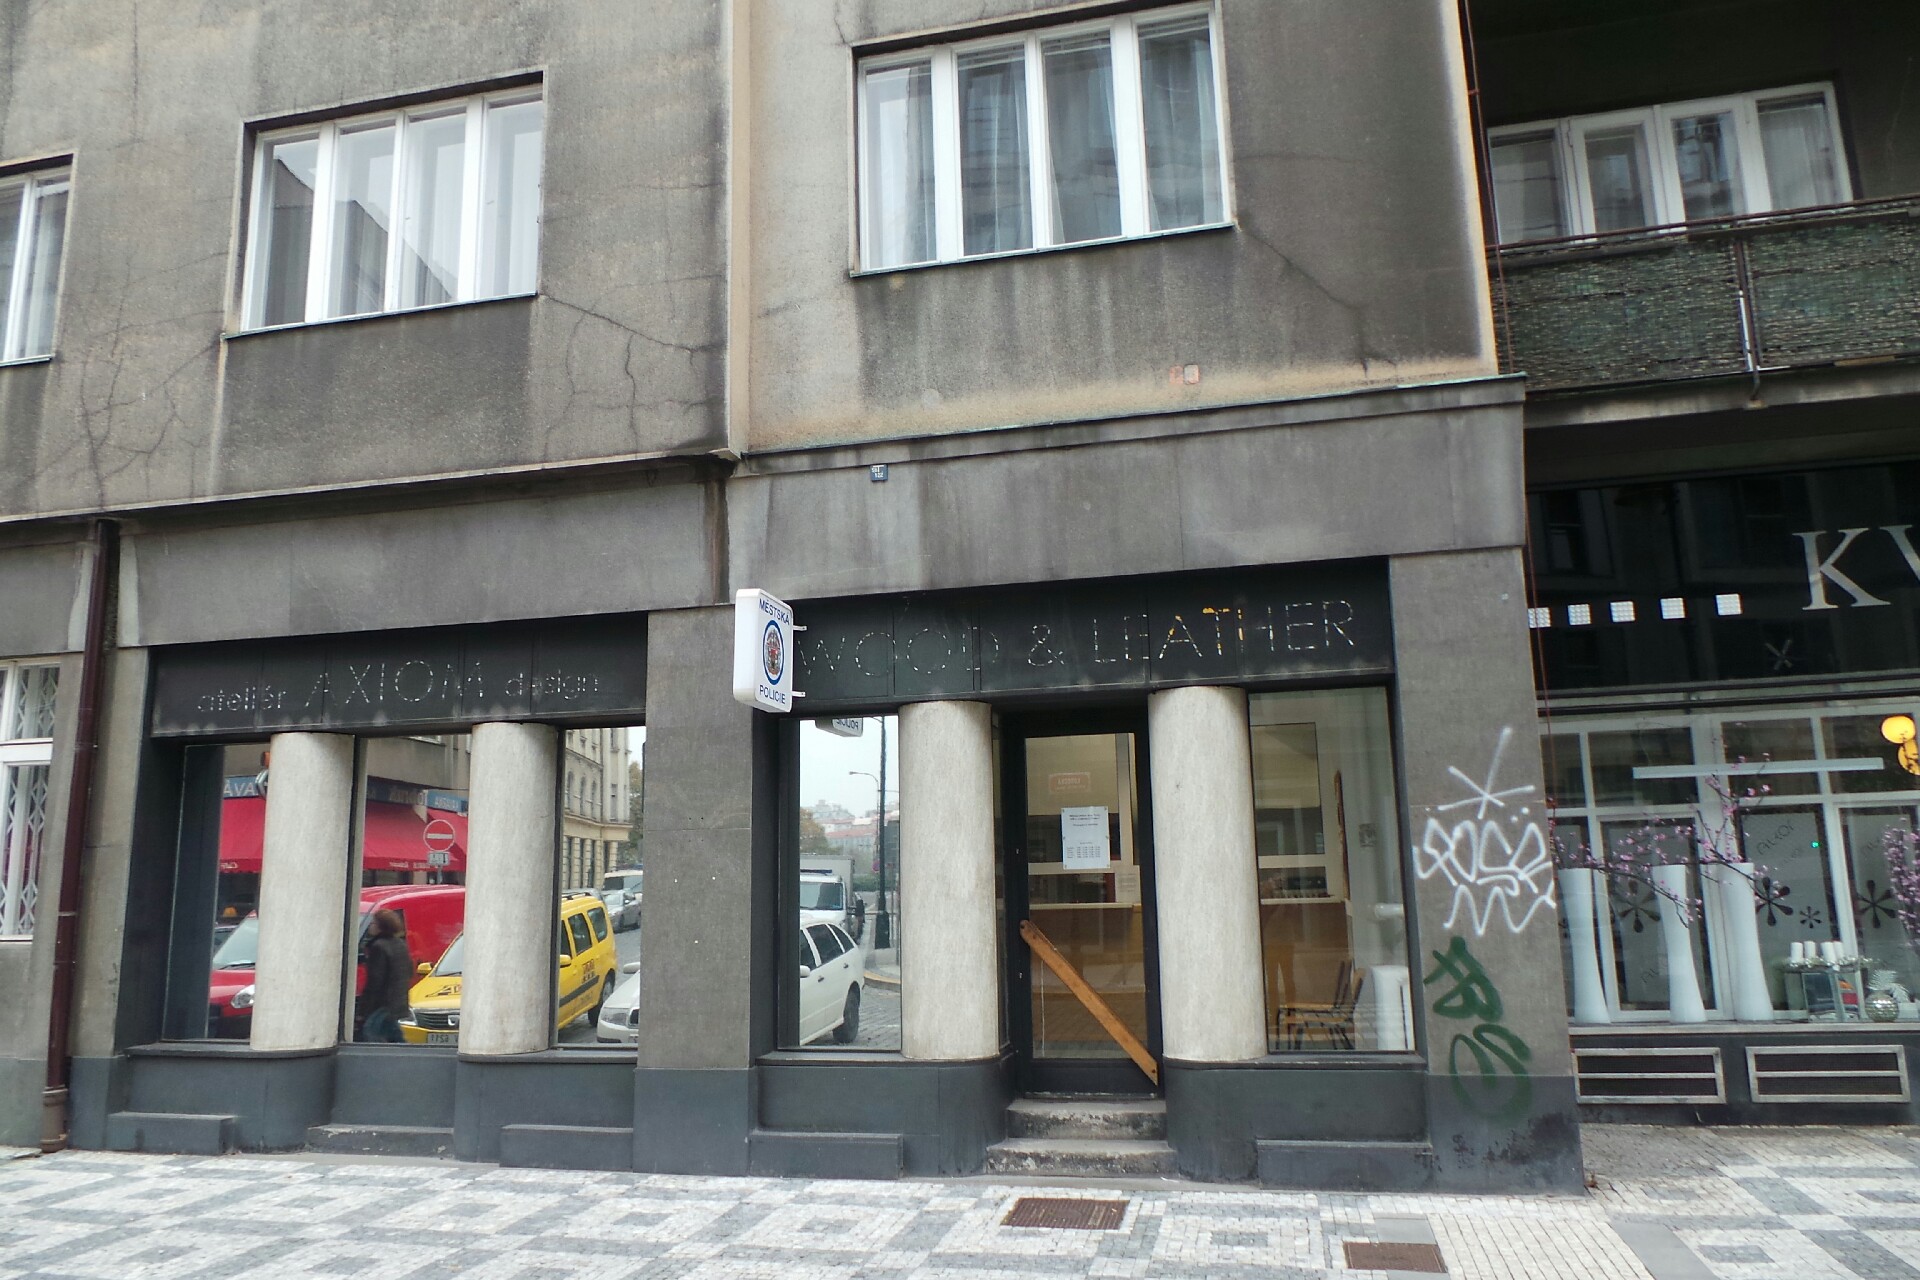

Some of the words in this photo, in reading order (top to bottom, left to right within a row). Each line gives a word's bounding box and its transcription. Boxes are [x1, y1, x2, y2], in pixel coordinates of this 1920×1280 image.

[758, 597, 790, 626] MĚSTSKÁ
[798, 626, 999, 676] WOOD
[1027, 624, 1065, 667] &
[1094, 600, 1354, 663] LEATHER
[305, 660, 483, 706] AXIOM
[505, 669, 598, 699] design
[758, 684, 786, 705] POLICIE
